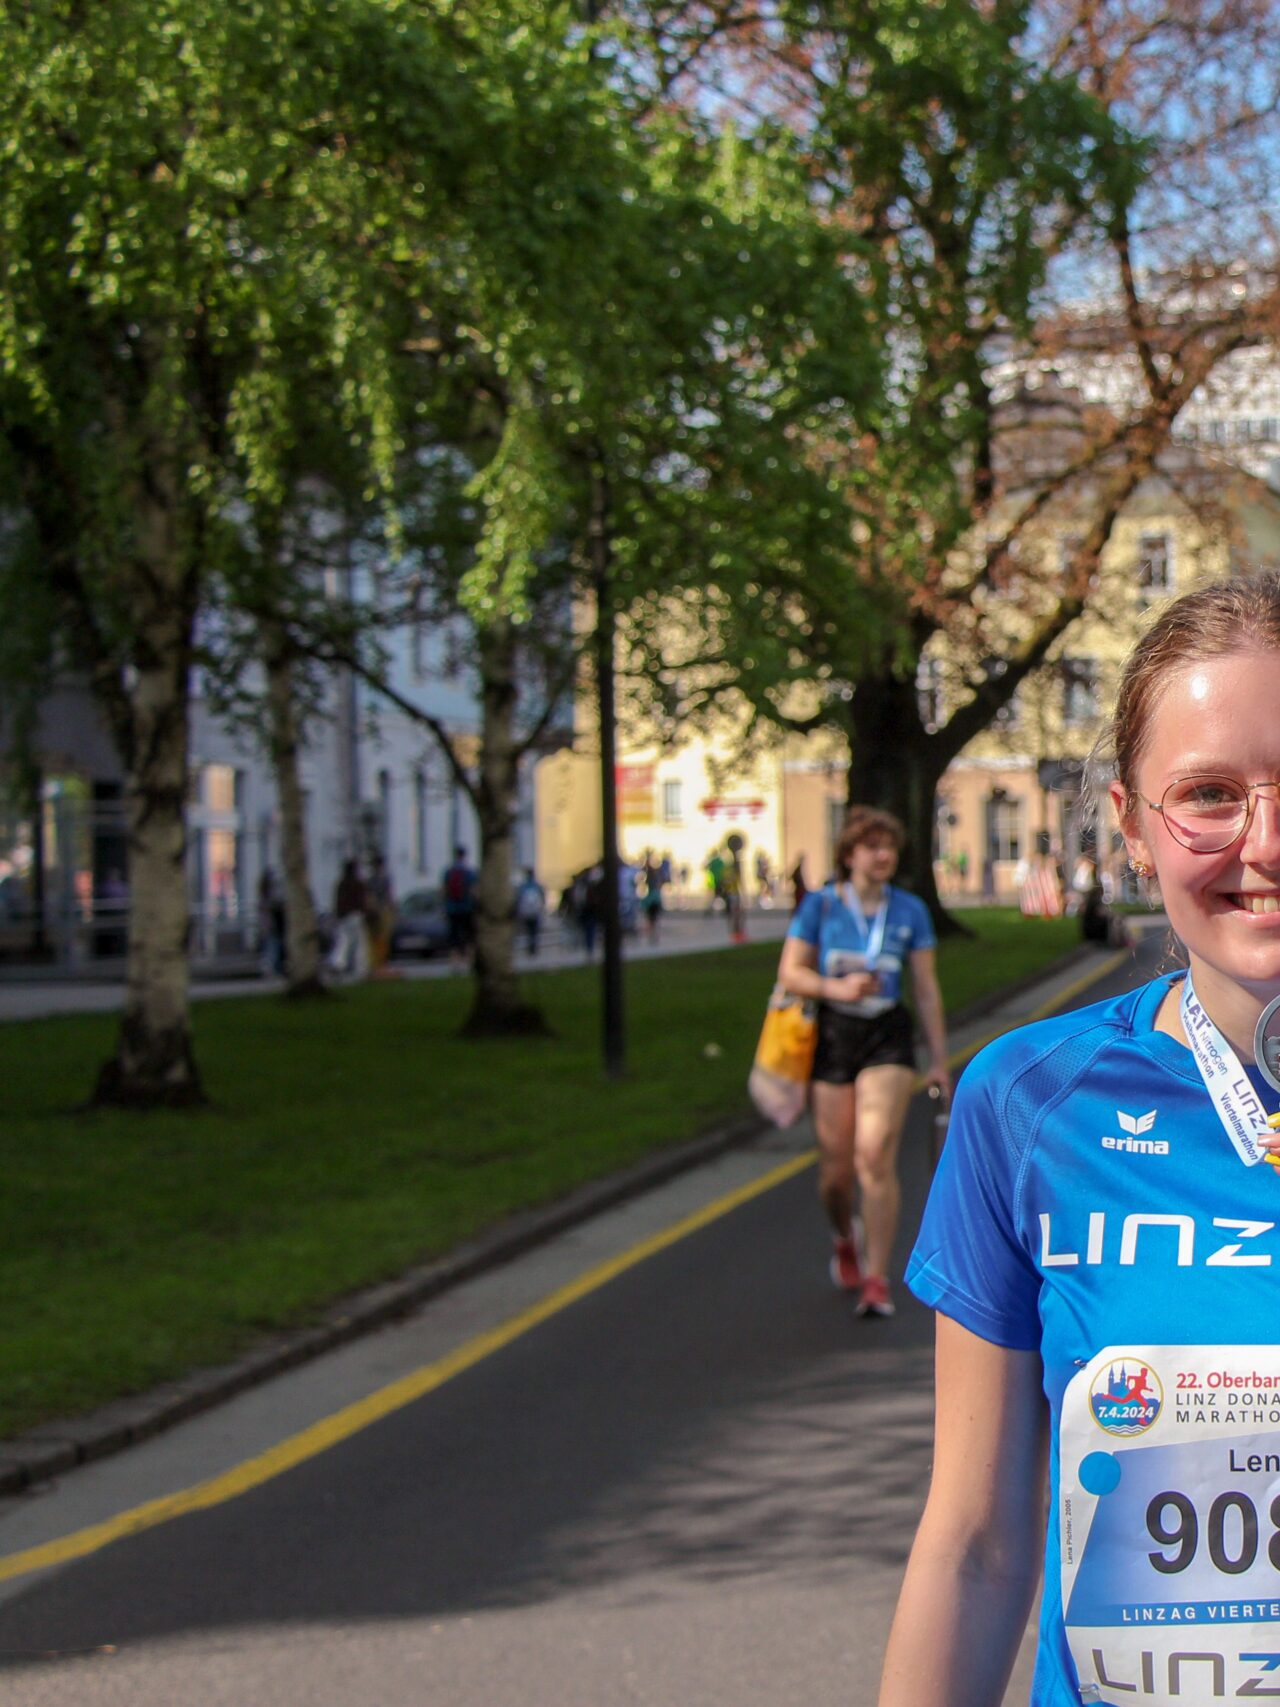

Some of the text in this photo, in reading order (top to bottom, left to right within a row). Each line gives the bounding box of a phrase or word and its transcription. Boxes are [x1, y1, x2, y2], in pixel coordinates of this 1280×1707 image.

[1200, 1031, 1228, 1075] Nitrogen
[1220, 1092, 1259, 1161] Viertelmarathon
[1102, 1136, 1169, 1155] erima
[1176, 1373, 1202, 1388] 22.
[1176, 1393, 1216, 1405] LINZ
[1098, 1406, 1154, 1418] 7.4.2024
[1123, 1607, 1196, 1622] LINZAG
